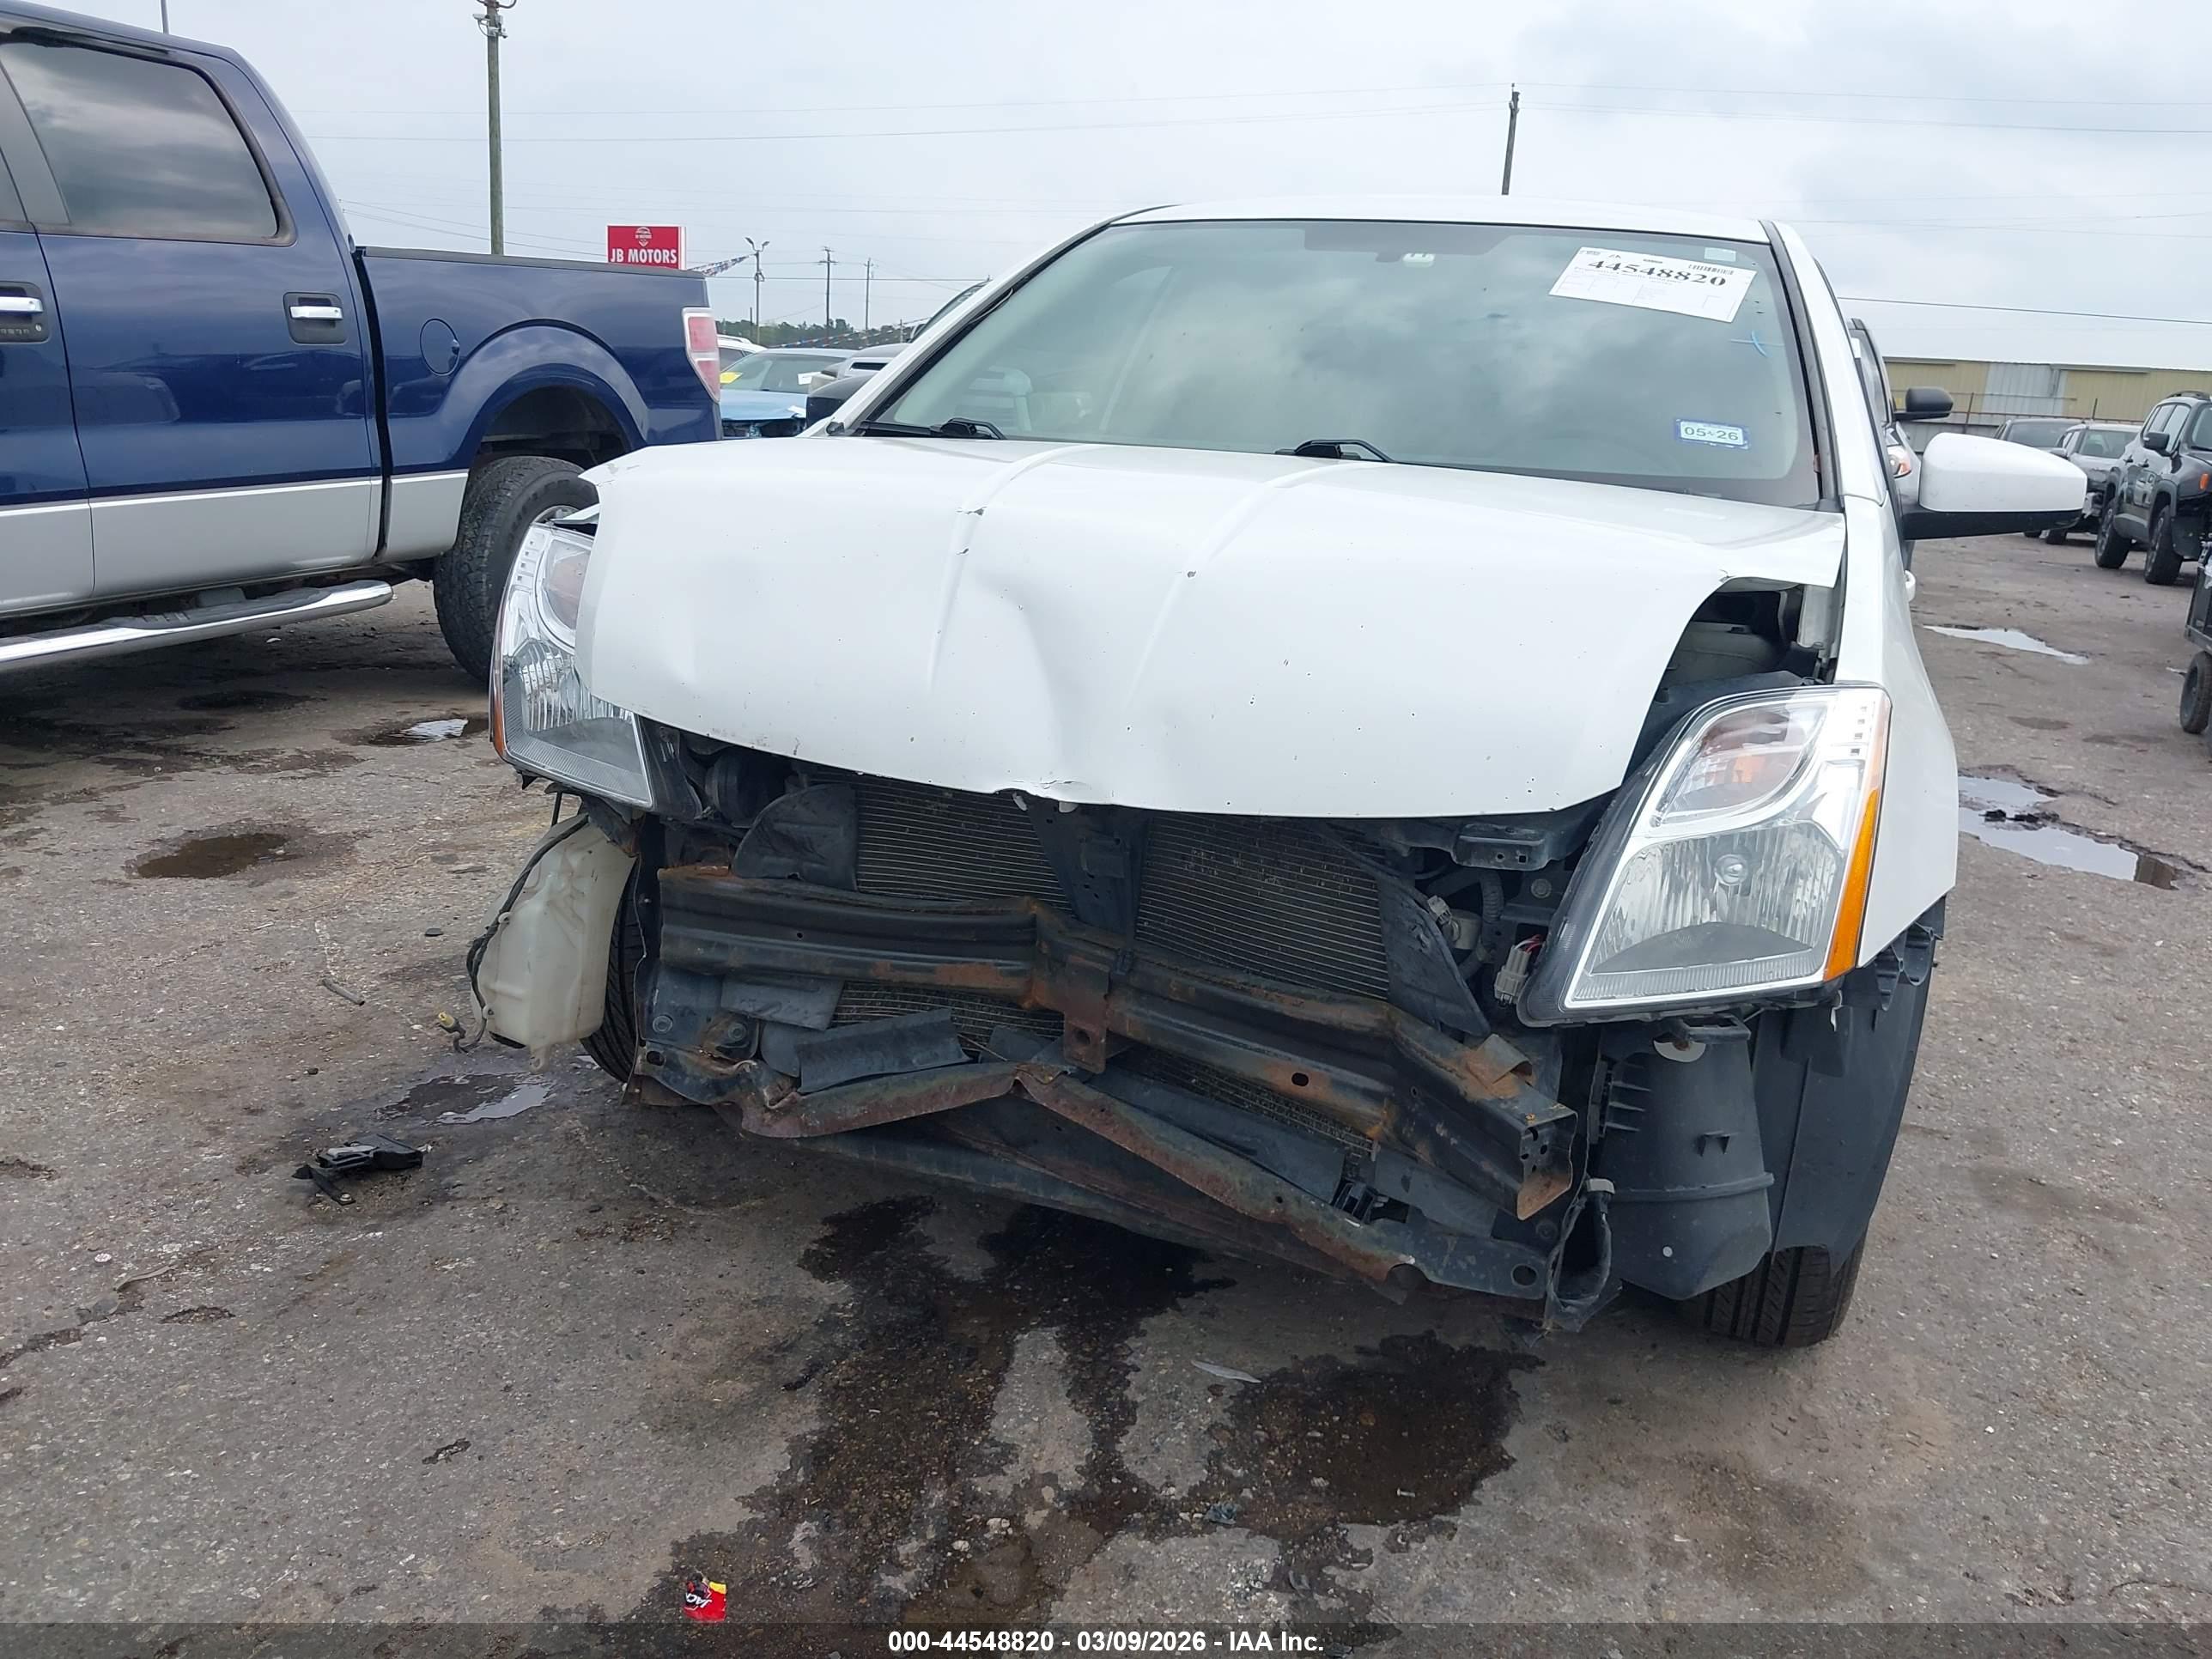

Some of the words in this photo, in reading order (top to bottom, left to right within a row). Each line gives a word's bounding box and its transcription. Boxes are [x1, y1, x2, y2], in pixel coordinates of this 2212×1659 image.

[611, 248, 624, 263] JB
[628, 248, 677, 263] MOTORS
[1589, 260, 1726, 286] 44548820
